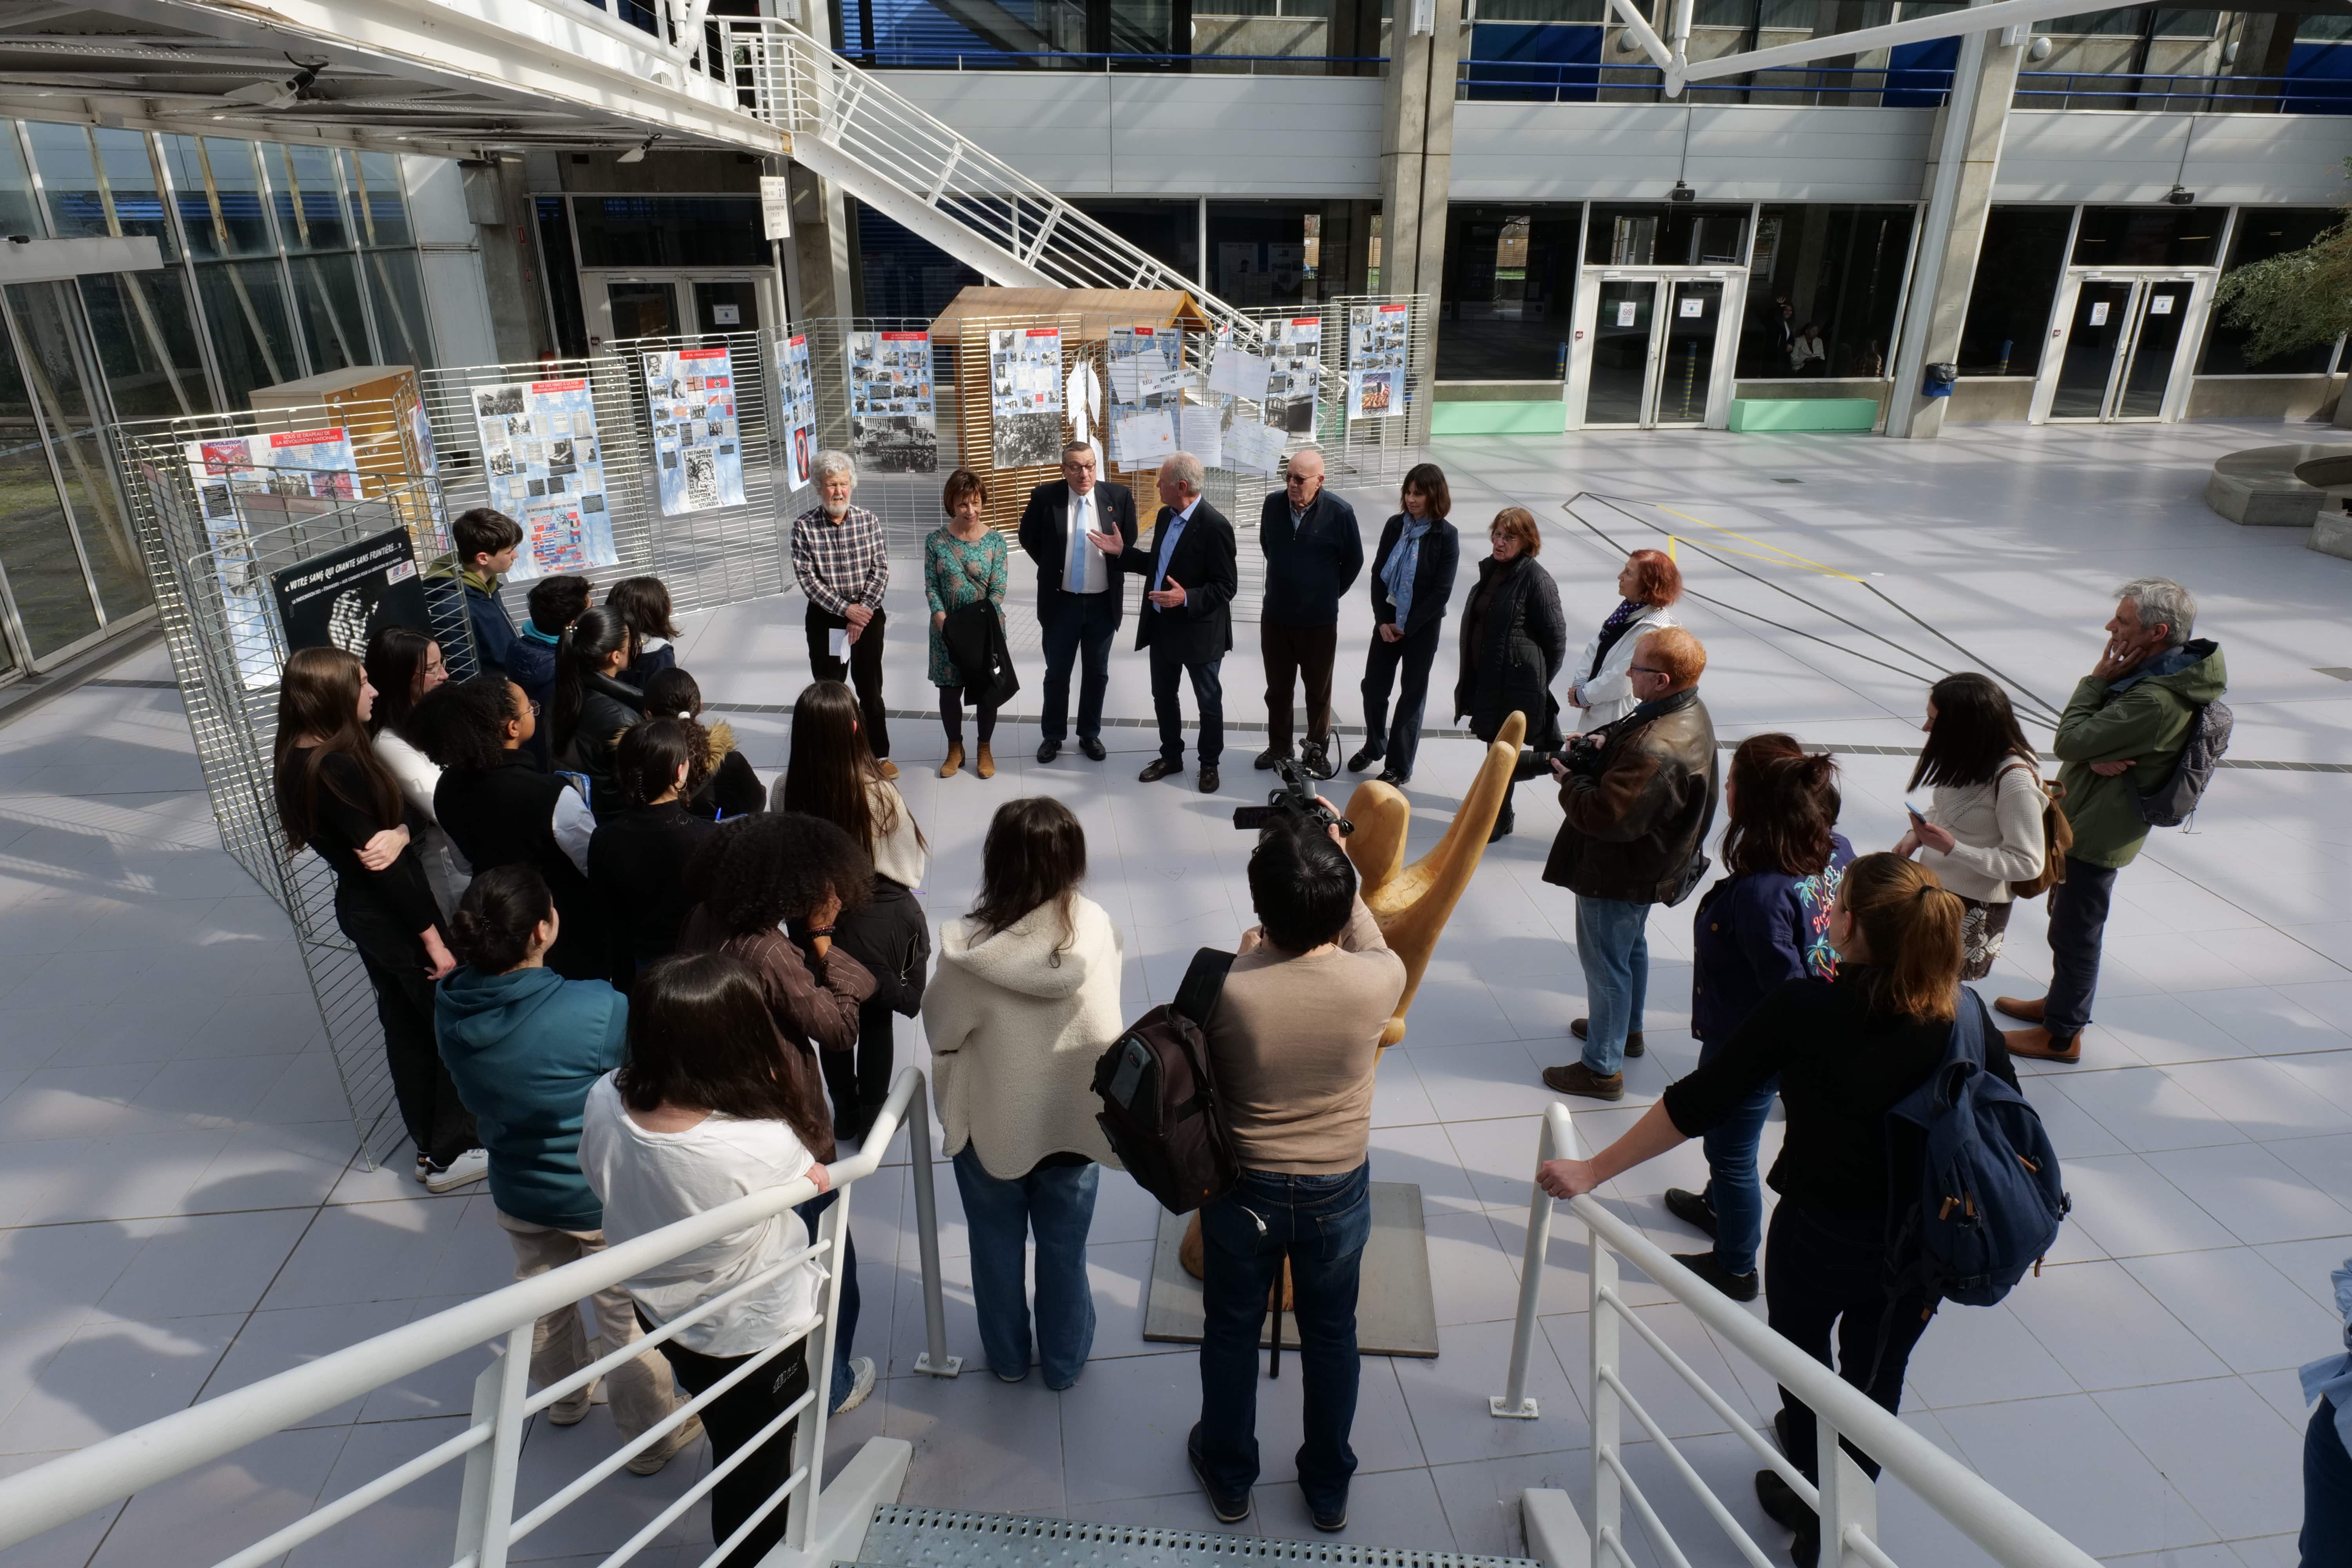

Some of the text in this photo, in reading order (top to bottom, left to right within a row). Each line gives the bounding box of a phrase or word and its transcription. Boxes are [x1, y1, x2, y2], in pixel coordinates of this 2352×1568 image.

[290, 576, 308, 590] VOTRE
[309, 570, 324, 583] SANG
[325, 566, 334, 579] QUI
[335, 558, 356, 573] CHANTE
[356, 553, 369, 565] SANS
[296, 591, 316, 603] PARTICIPATION
[323, 581, 340, 591] ÉTRANGERS
[348, 573, 361, 582] COMBATS
[371, 564, 385, 572] LIBÉRATION
